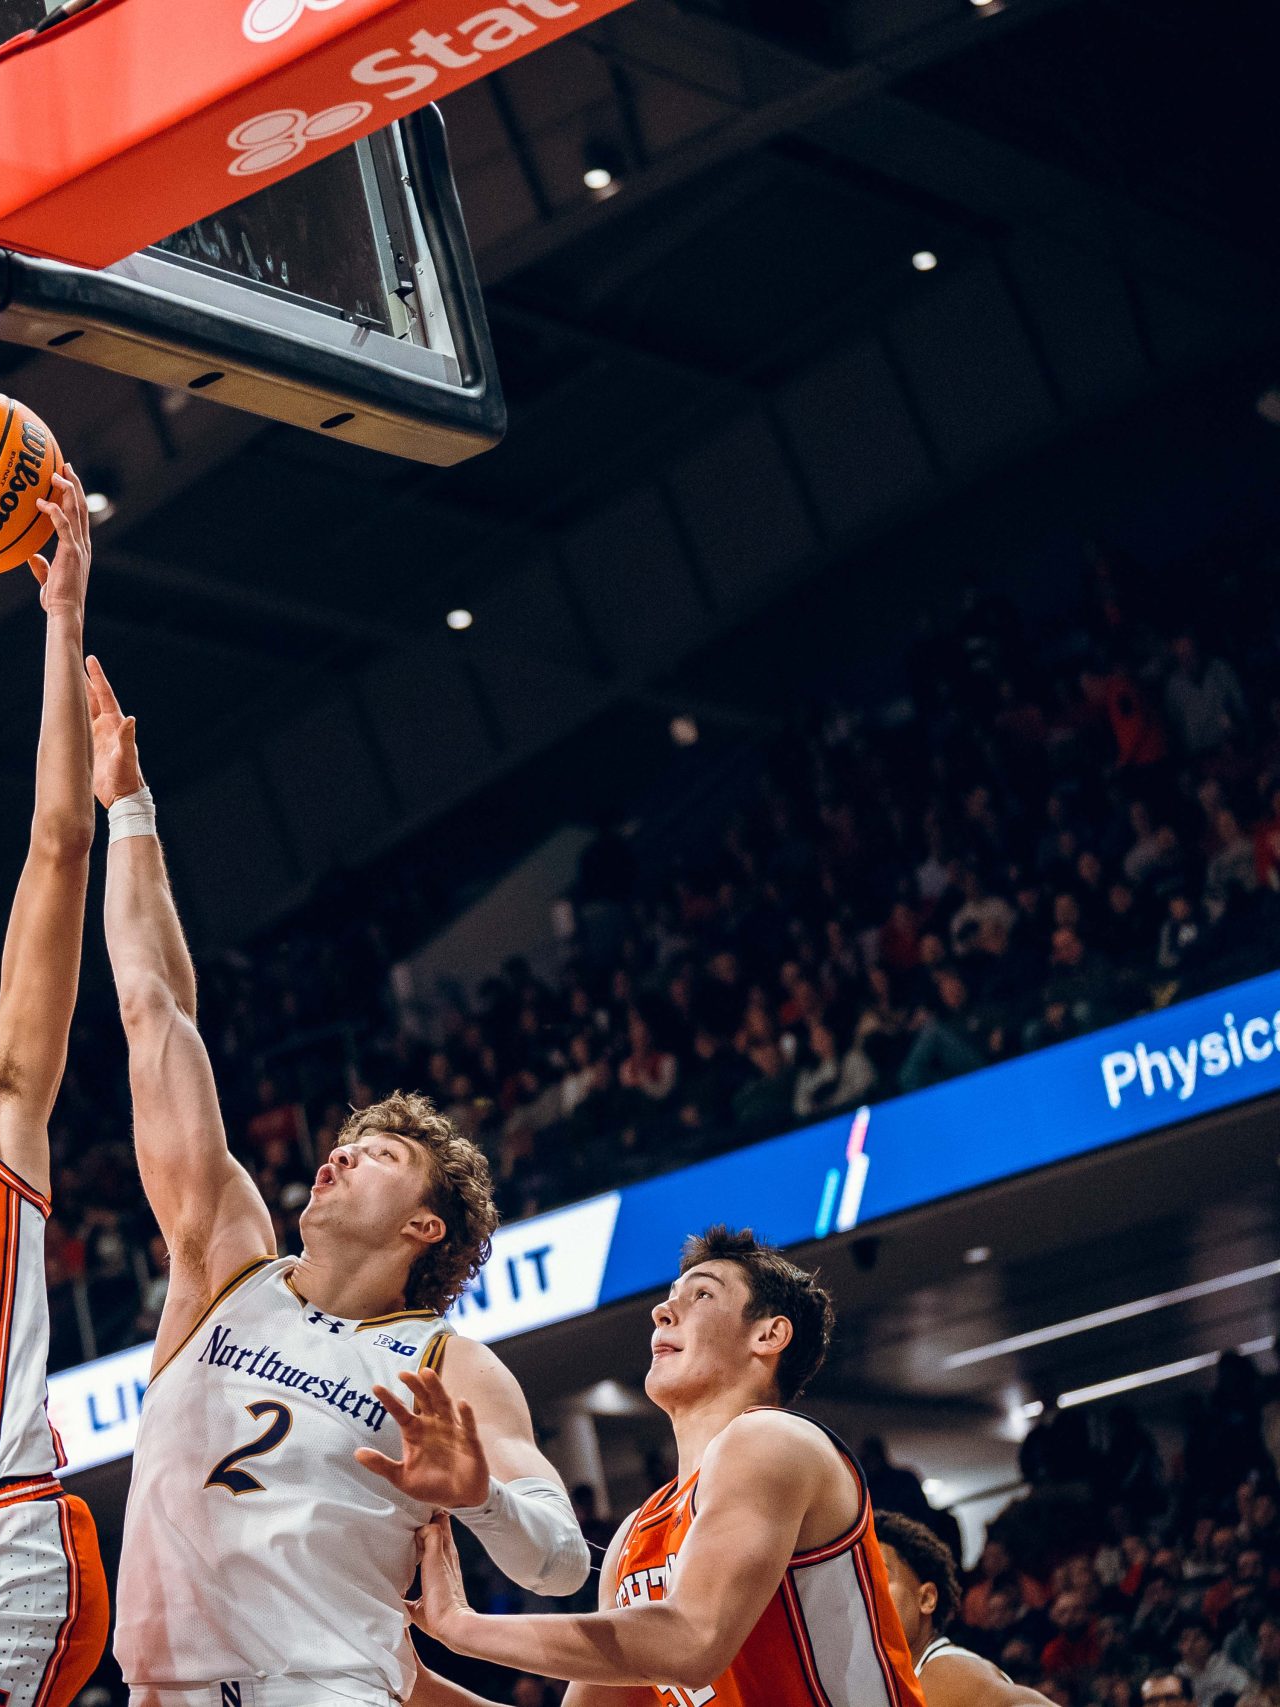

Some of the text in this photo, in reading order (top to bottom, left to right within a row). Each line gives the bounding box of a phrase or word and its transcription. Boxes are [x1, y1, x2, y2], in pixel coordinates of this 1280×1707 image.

[507, 1244, 553, 1301] IT
[199, 1325, 388, 1432] Northwestern
[204, 1400, 294, 1496] 2
